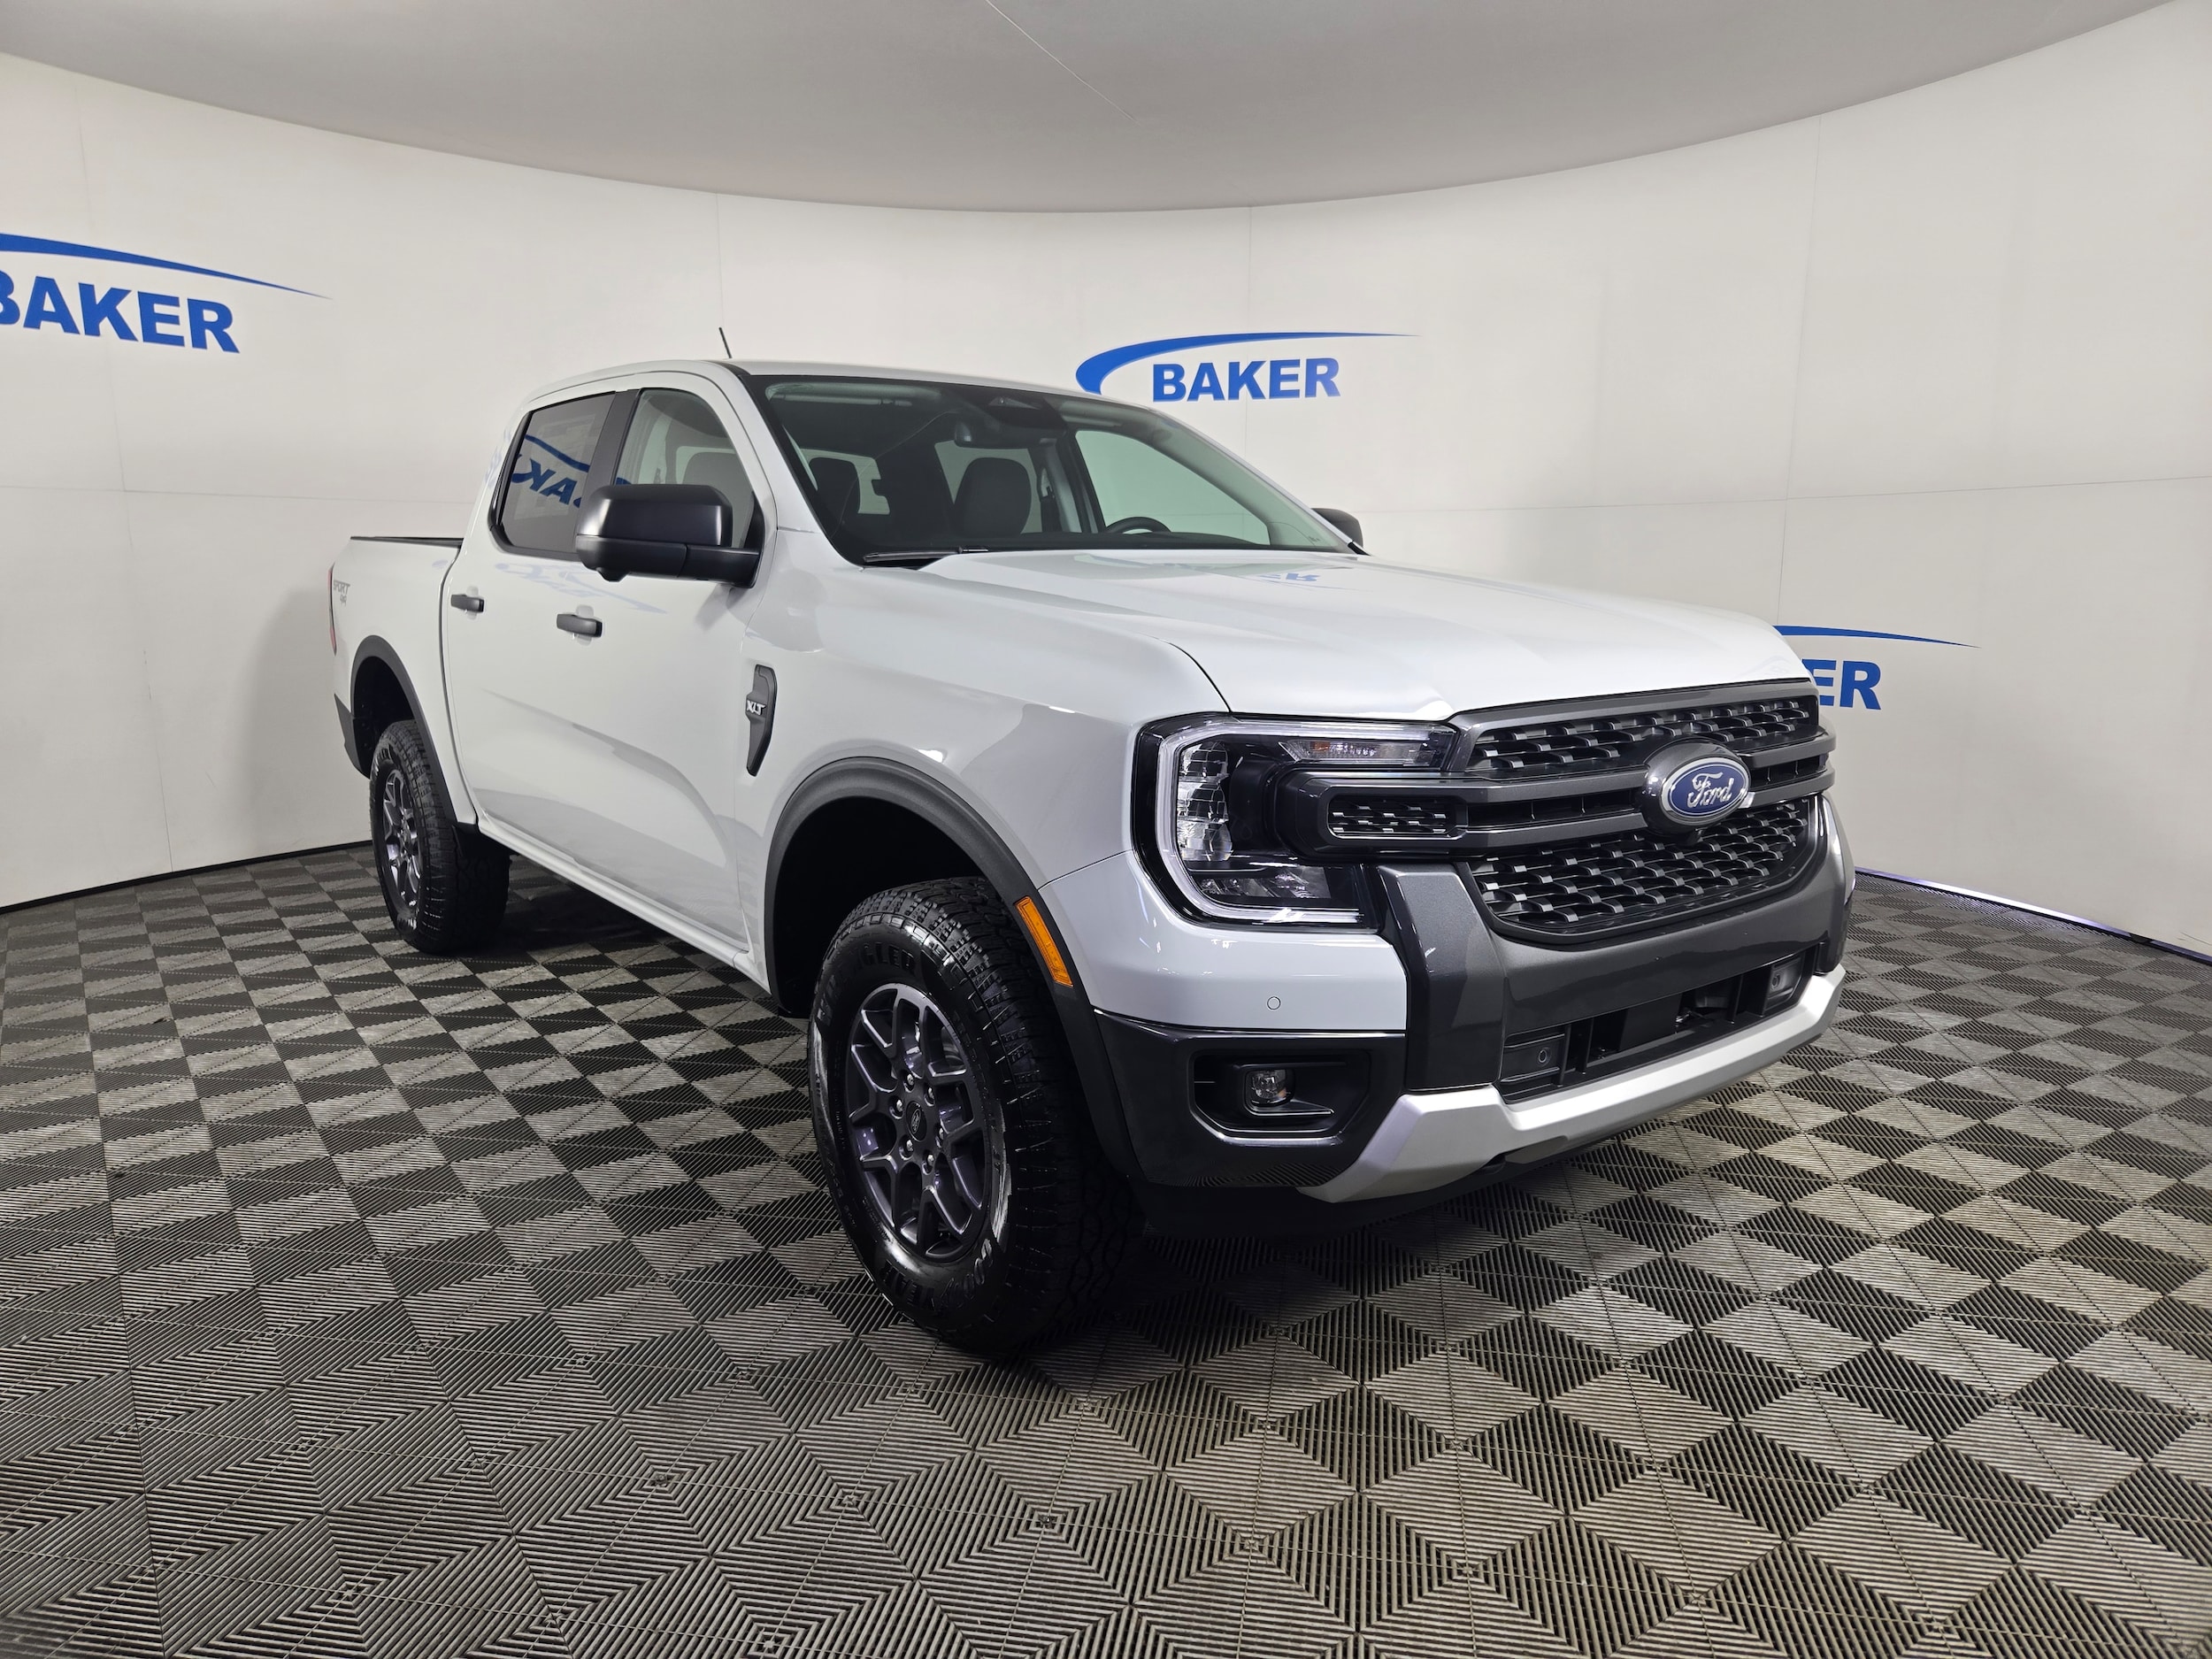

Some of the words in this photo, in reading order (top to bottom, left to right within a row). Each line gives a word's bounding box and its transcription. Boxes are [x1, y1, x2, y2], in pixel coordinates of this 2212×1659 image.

[1153, 357, 1341, 403] BAKER
[746, 699, 766, 716] XLT
[1686, 772, 1734, 809] Ford
